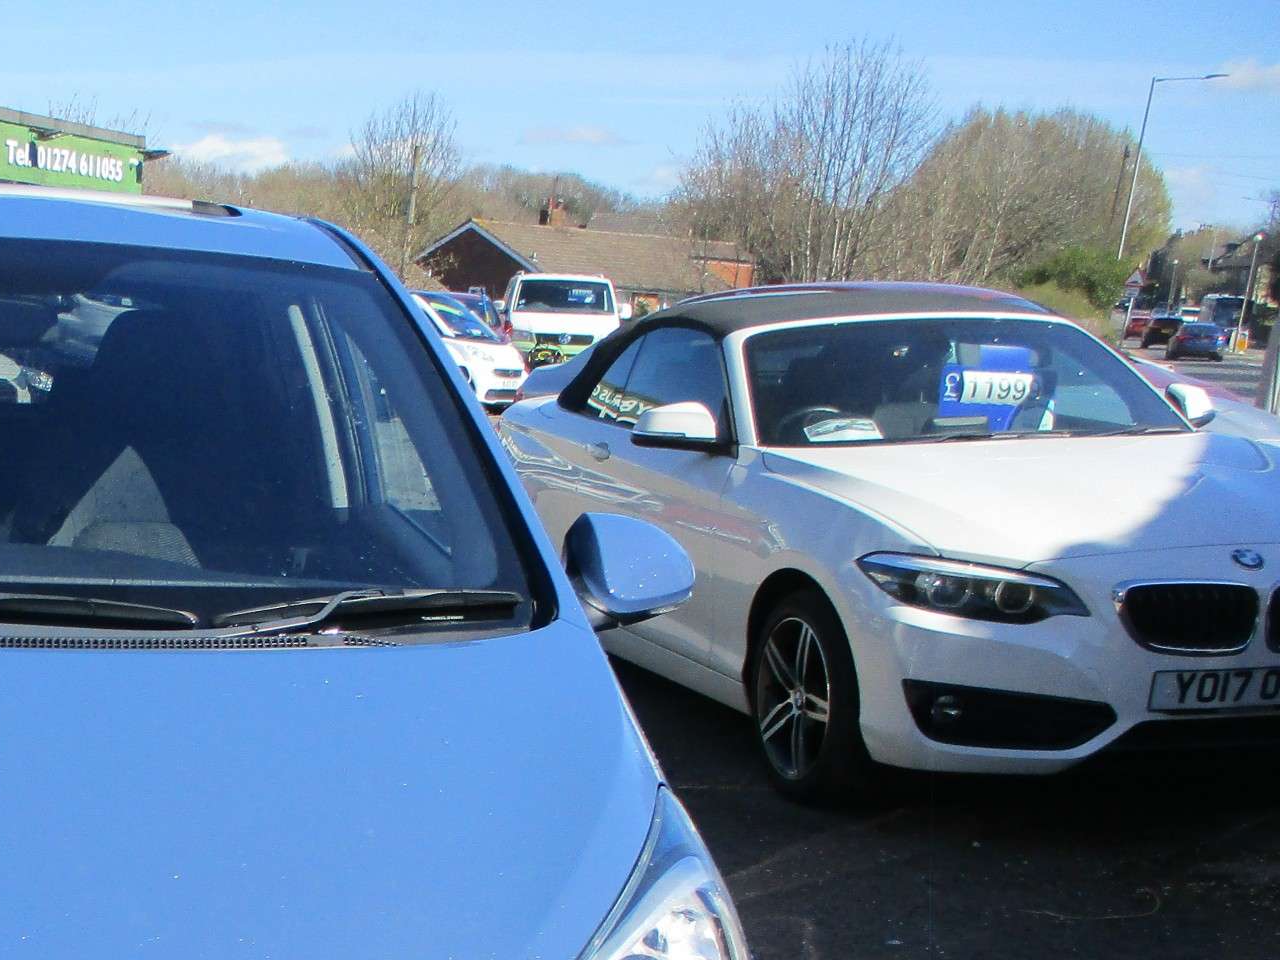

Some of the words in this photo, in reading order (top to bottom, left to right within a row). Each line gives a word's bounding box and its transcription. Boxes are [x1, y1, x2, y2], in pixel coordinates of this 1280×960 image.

[37, 145, 77, 174] 01274
[80, 153, 123, 182] 611055
[1176, 670, 1252, 704] YO17
